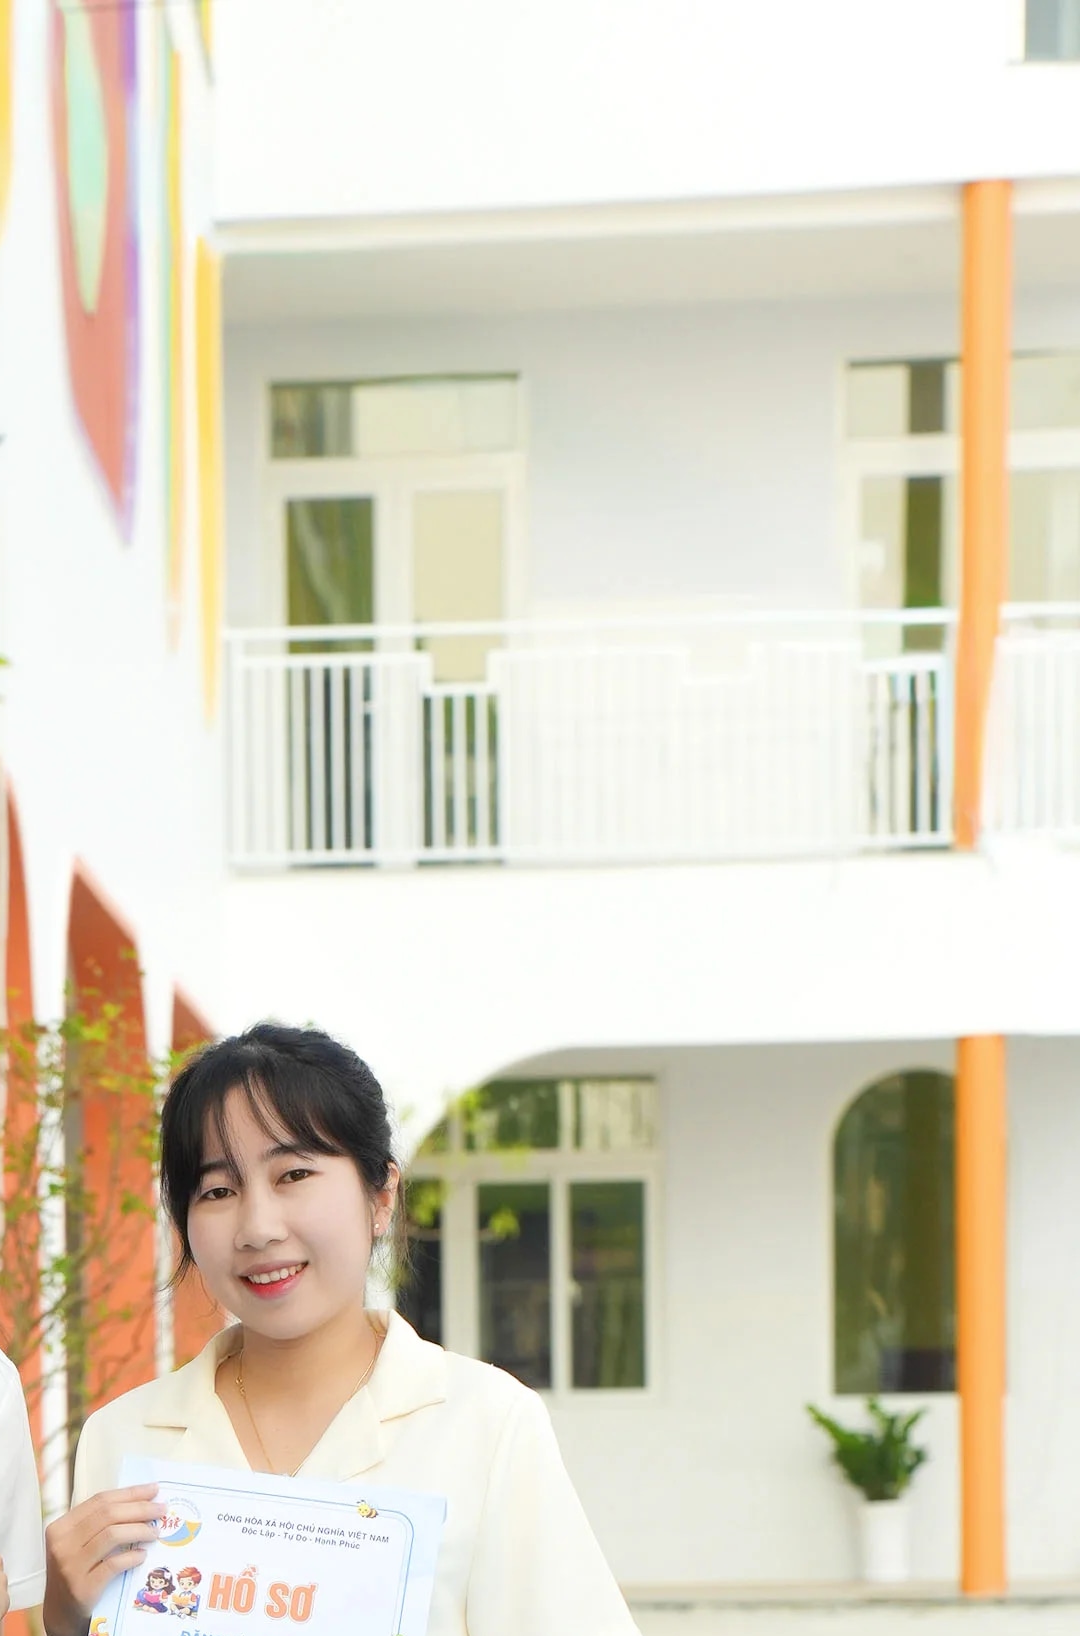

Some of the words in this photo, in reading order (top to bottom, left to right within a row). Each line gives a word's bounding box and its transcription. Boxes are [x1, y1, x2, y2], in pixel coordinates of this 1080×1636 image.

[241, 1526, 258, 1535] Độc
[259, 1529, 275, 1539] Lập
[283, 1532, 294, 1541] Tự
[296, 1534, 308, 1542] Do
[314, 1536, 337, 1546] Hạnh
[338, 1539, 360, 1550] Phúc
[265, 1518, 277, 1527] XÃ
[279, 1521, 295, 1530] HỘI
[296, 1522, 316, 1533] CHỦ
[317, 1526, 345, 1537] NGHĨA
[348, 1530, 367, 1540] VIỆT
[369, 1534, 389, 1543] NAM
[208, 1565, 257, 1614] HỒ
[265, 1581, 318, 1623] SƠ
